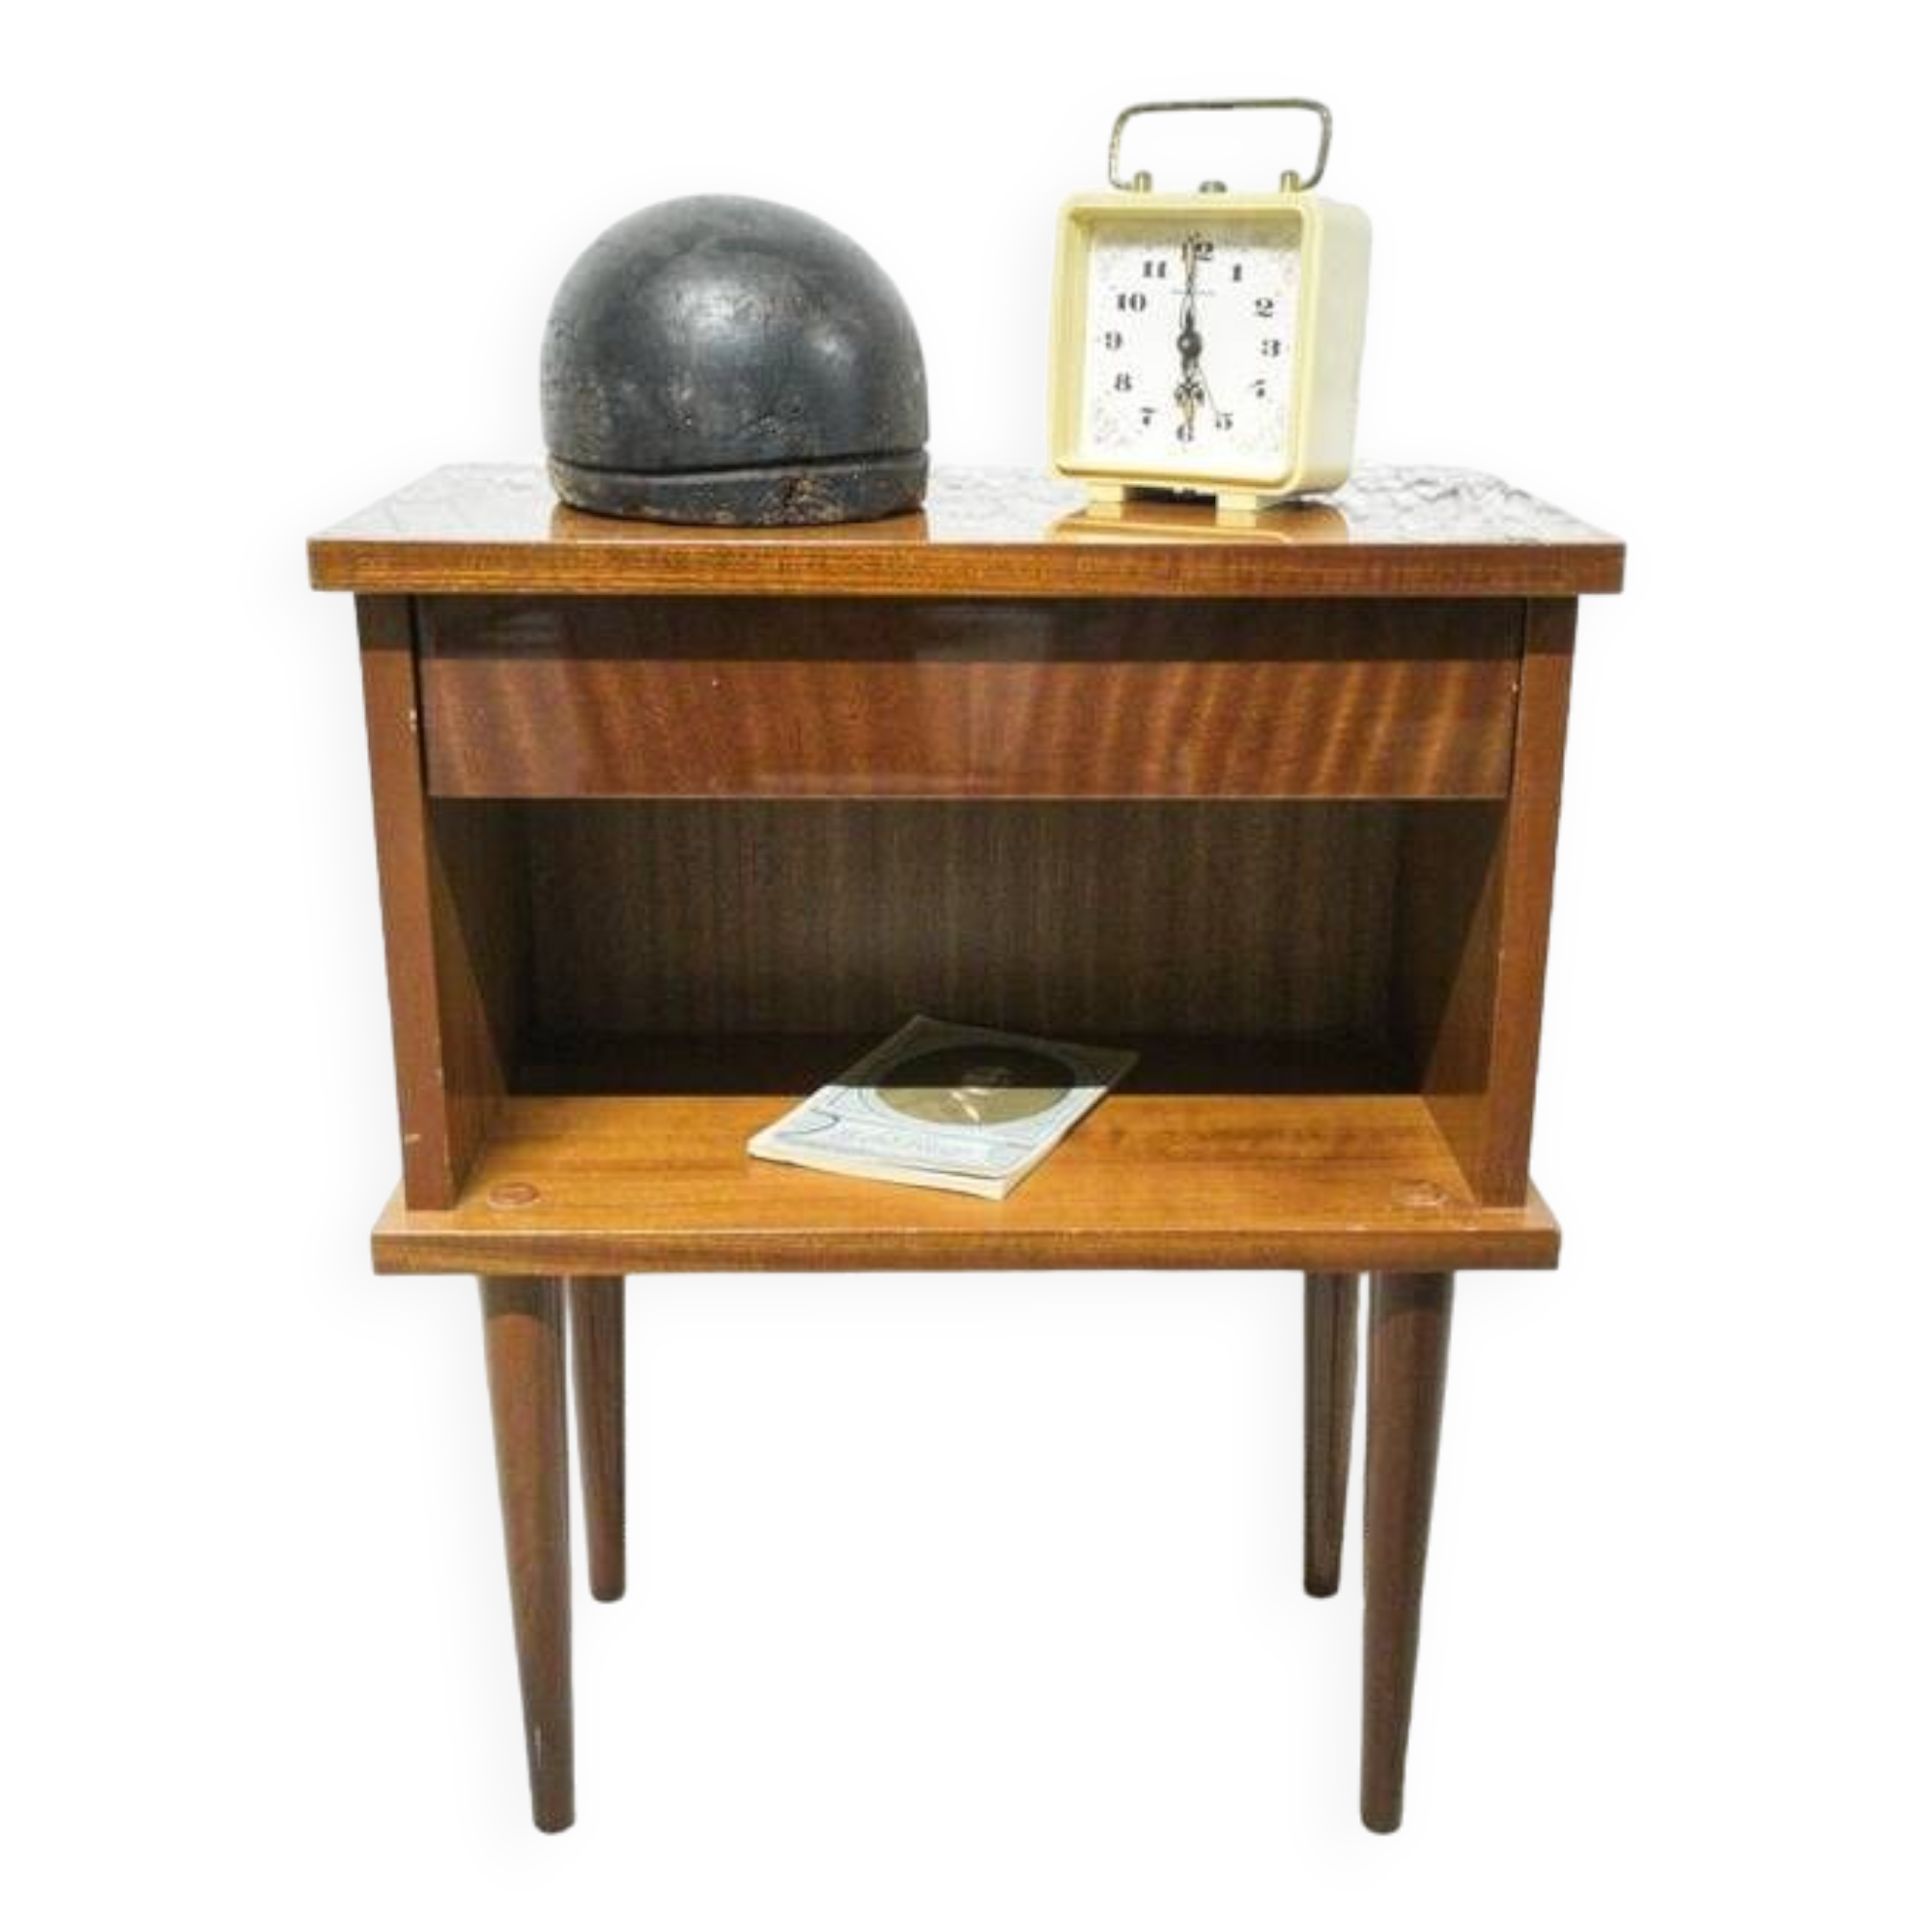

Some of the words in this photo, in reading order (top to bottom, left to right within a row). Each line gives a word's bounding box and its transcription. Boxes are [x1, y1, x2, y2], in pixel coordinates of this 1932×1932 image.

[1143, 260, 1168, 278] 11
[1232, 263, 1242, 282] 1
[1117, 293, 1147, 312] 10
[1256, 298, 1274, 318] 2
[1105, 331, 1122, 351] 9
[1261, 339, 1281, 357] 3
[1114, 373, 1132, 391] 8
[1140, 407, 1156, 426] 7
[1214, 412, 1234, 431] 5
